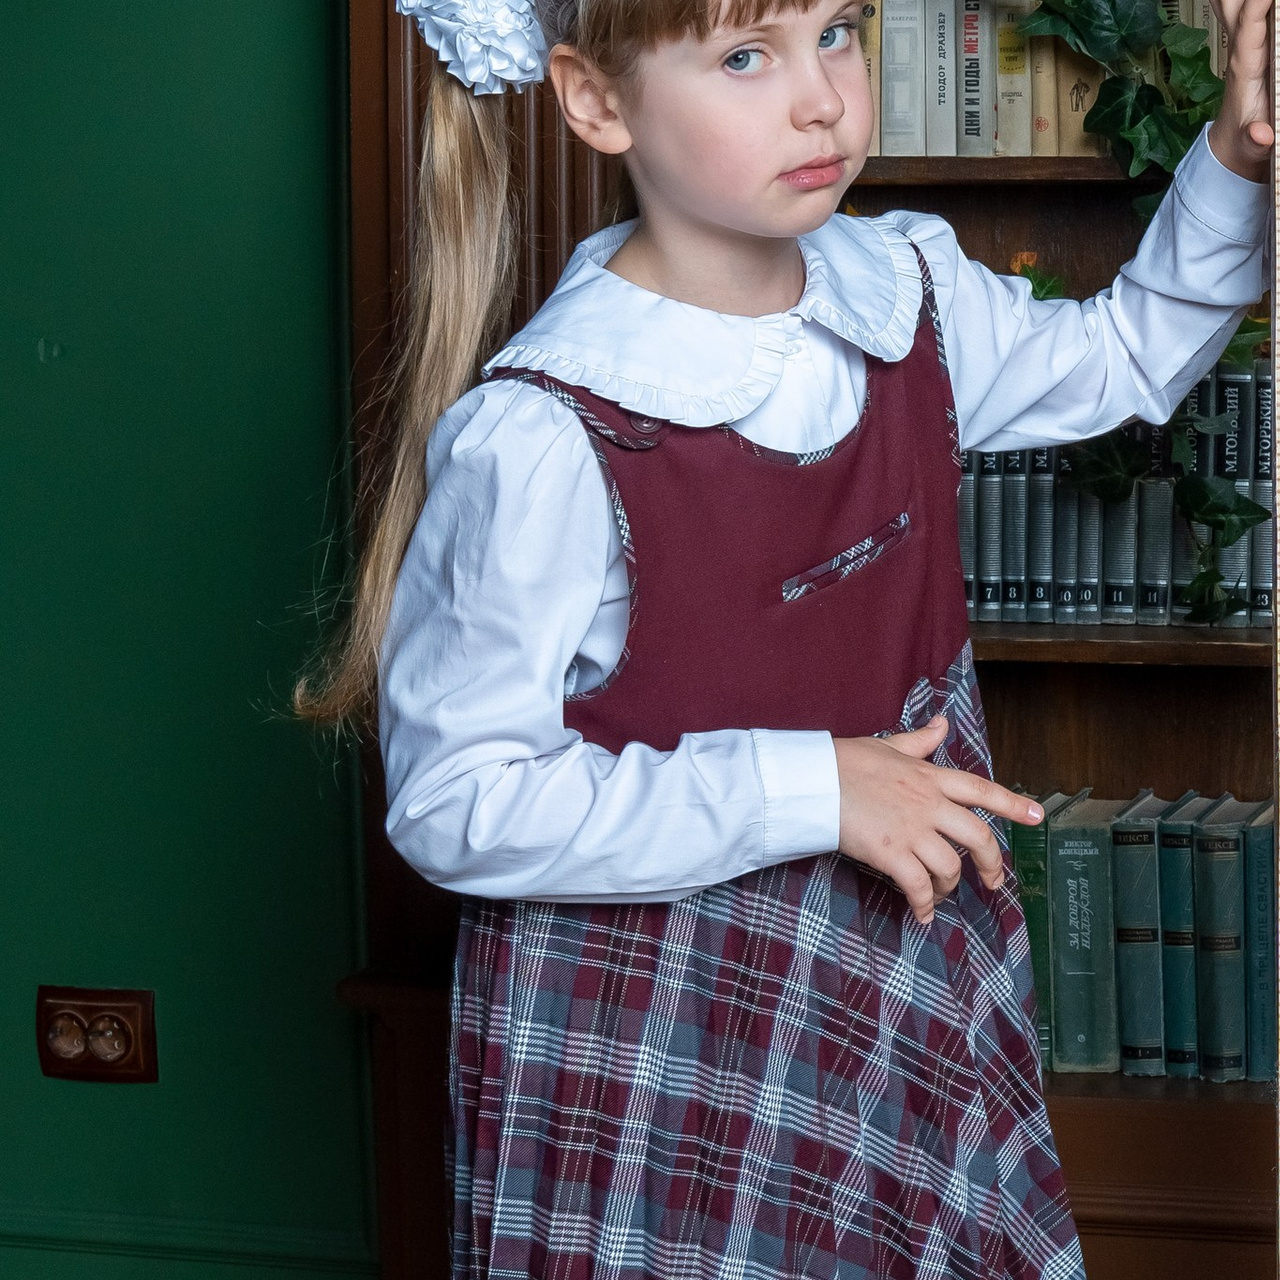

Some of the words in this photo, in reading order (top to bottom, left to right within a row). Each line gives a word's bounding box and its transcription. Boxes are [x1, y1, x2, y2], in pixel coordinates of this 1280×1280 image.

[938, 11, 947, 59] ДРАЙЗЕР
[938, 64, 946, 105] ТЕОДОР
[965, 57, 980, 94] ГОДЫ
[971, 97, 980, 106] И
[965, 109, 981, 137] ДНИ
[1258, 387, 1272, 475] М.ГОРЬКИЙ
[985, 586, 993, 600] 7
[1008, 586, 1017, 599] 8
[1035, 586, 1044, 599] 8
[1111, 591, 1123, 603] 11
[1146, 591, 1158, 603] 11
[1067, 878, 1080, 929] ДОБРОЙ
[1069, 932, 1080, 950] ЗА
